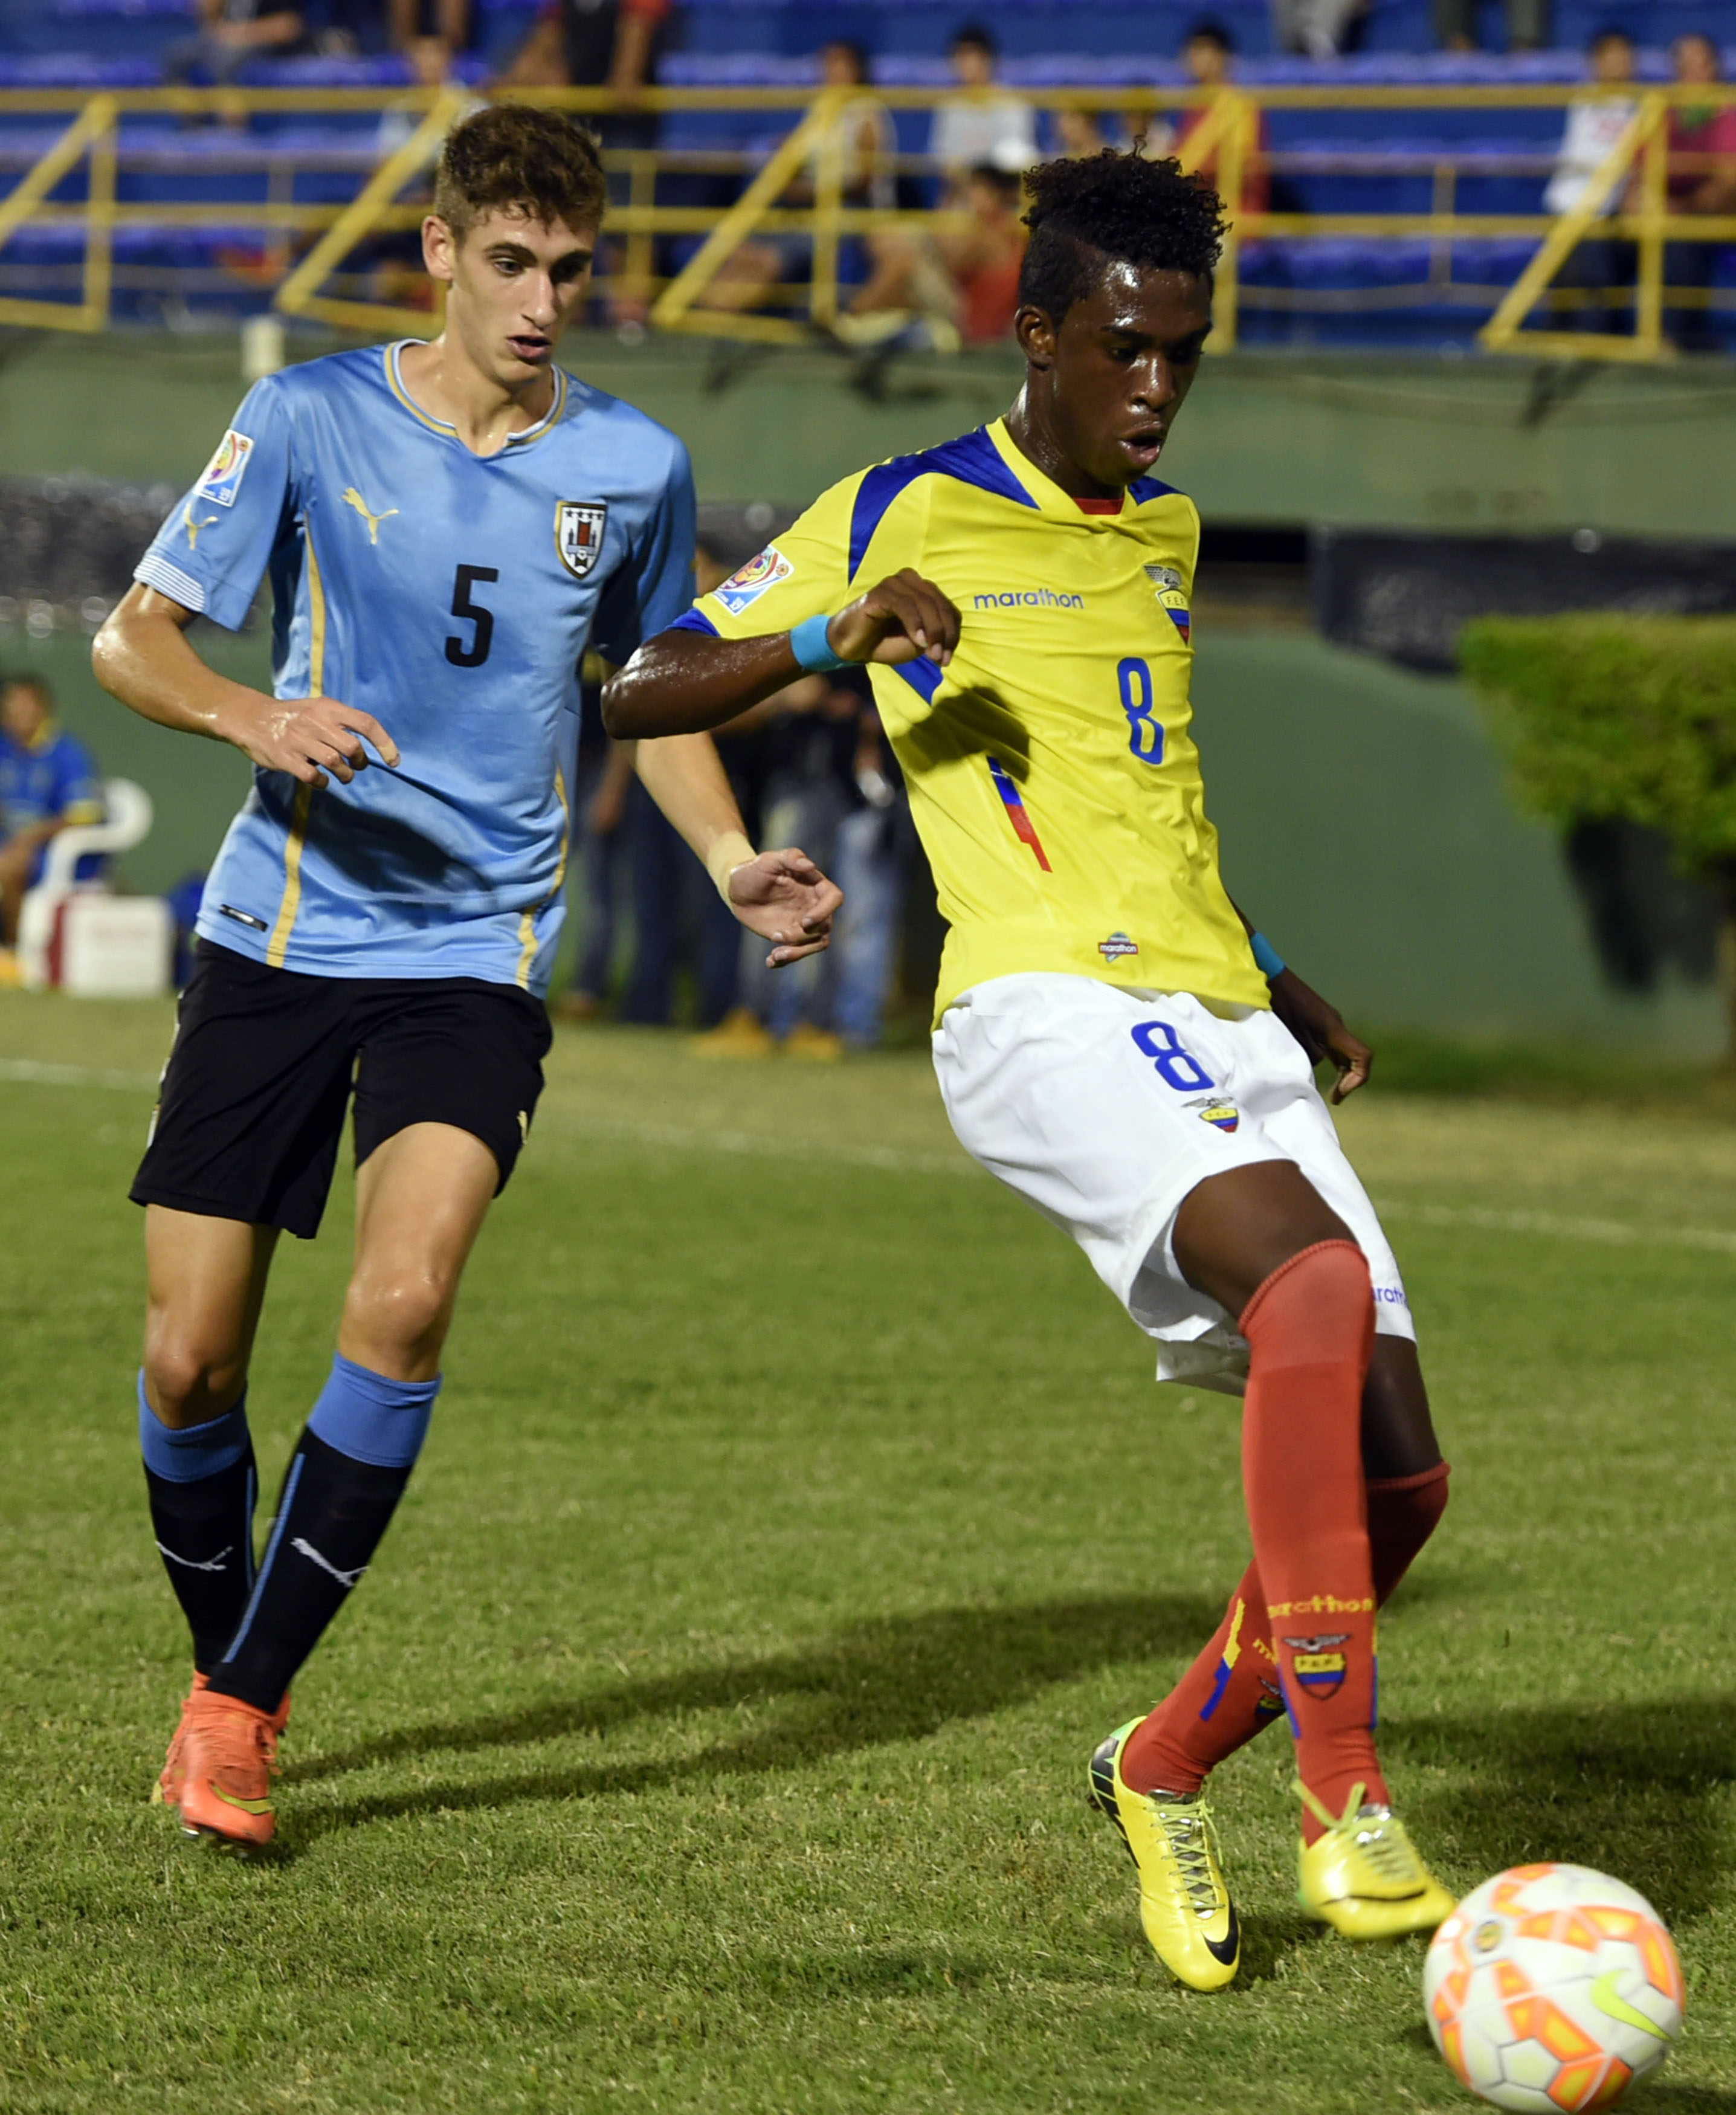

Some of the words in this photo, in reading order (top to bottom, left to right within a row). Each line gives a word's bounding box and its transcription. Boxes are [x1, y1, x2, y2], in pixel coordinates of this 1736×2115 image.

[445, 564, 499, 667] 5
[973, 589, 1085, 609] marathon
[1117, 657, 1166, 766] 8
[1100, 944, 1137, 953] marathon
[1131, 1021, 1215, 1091] 8
